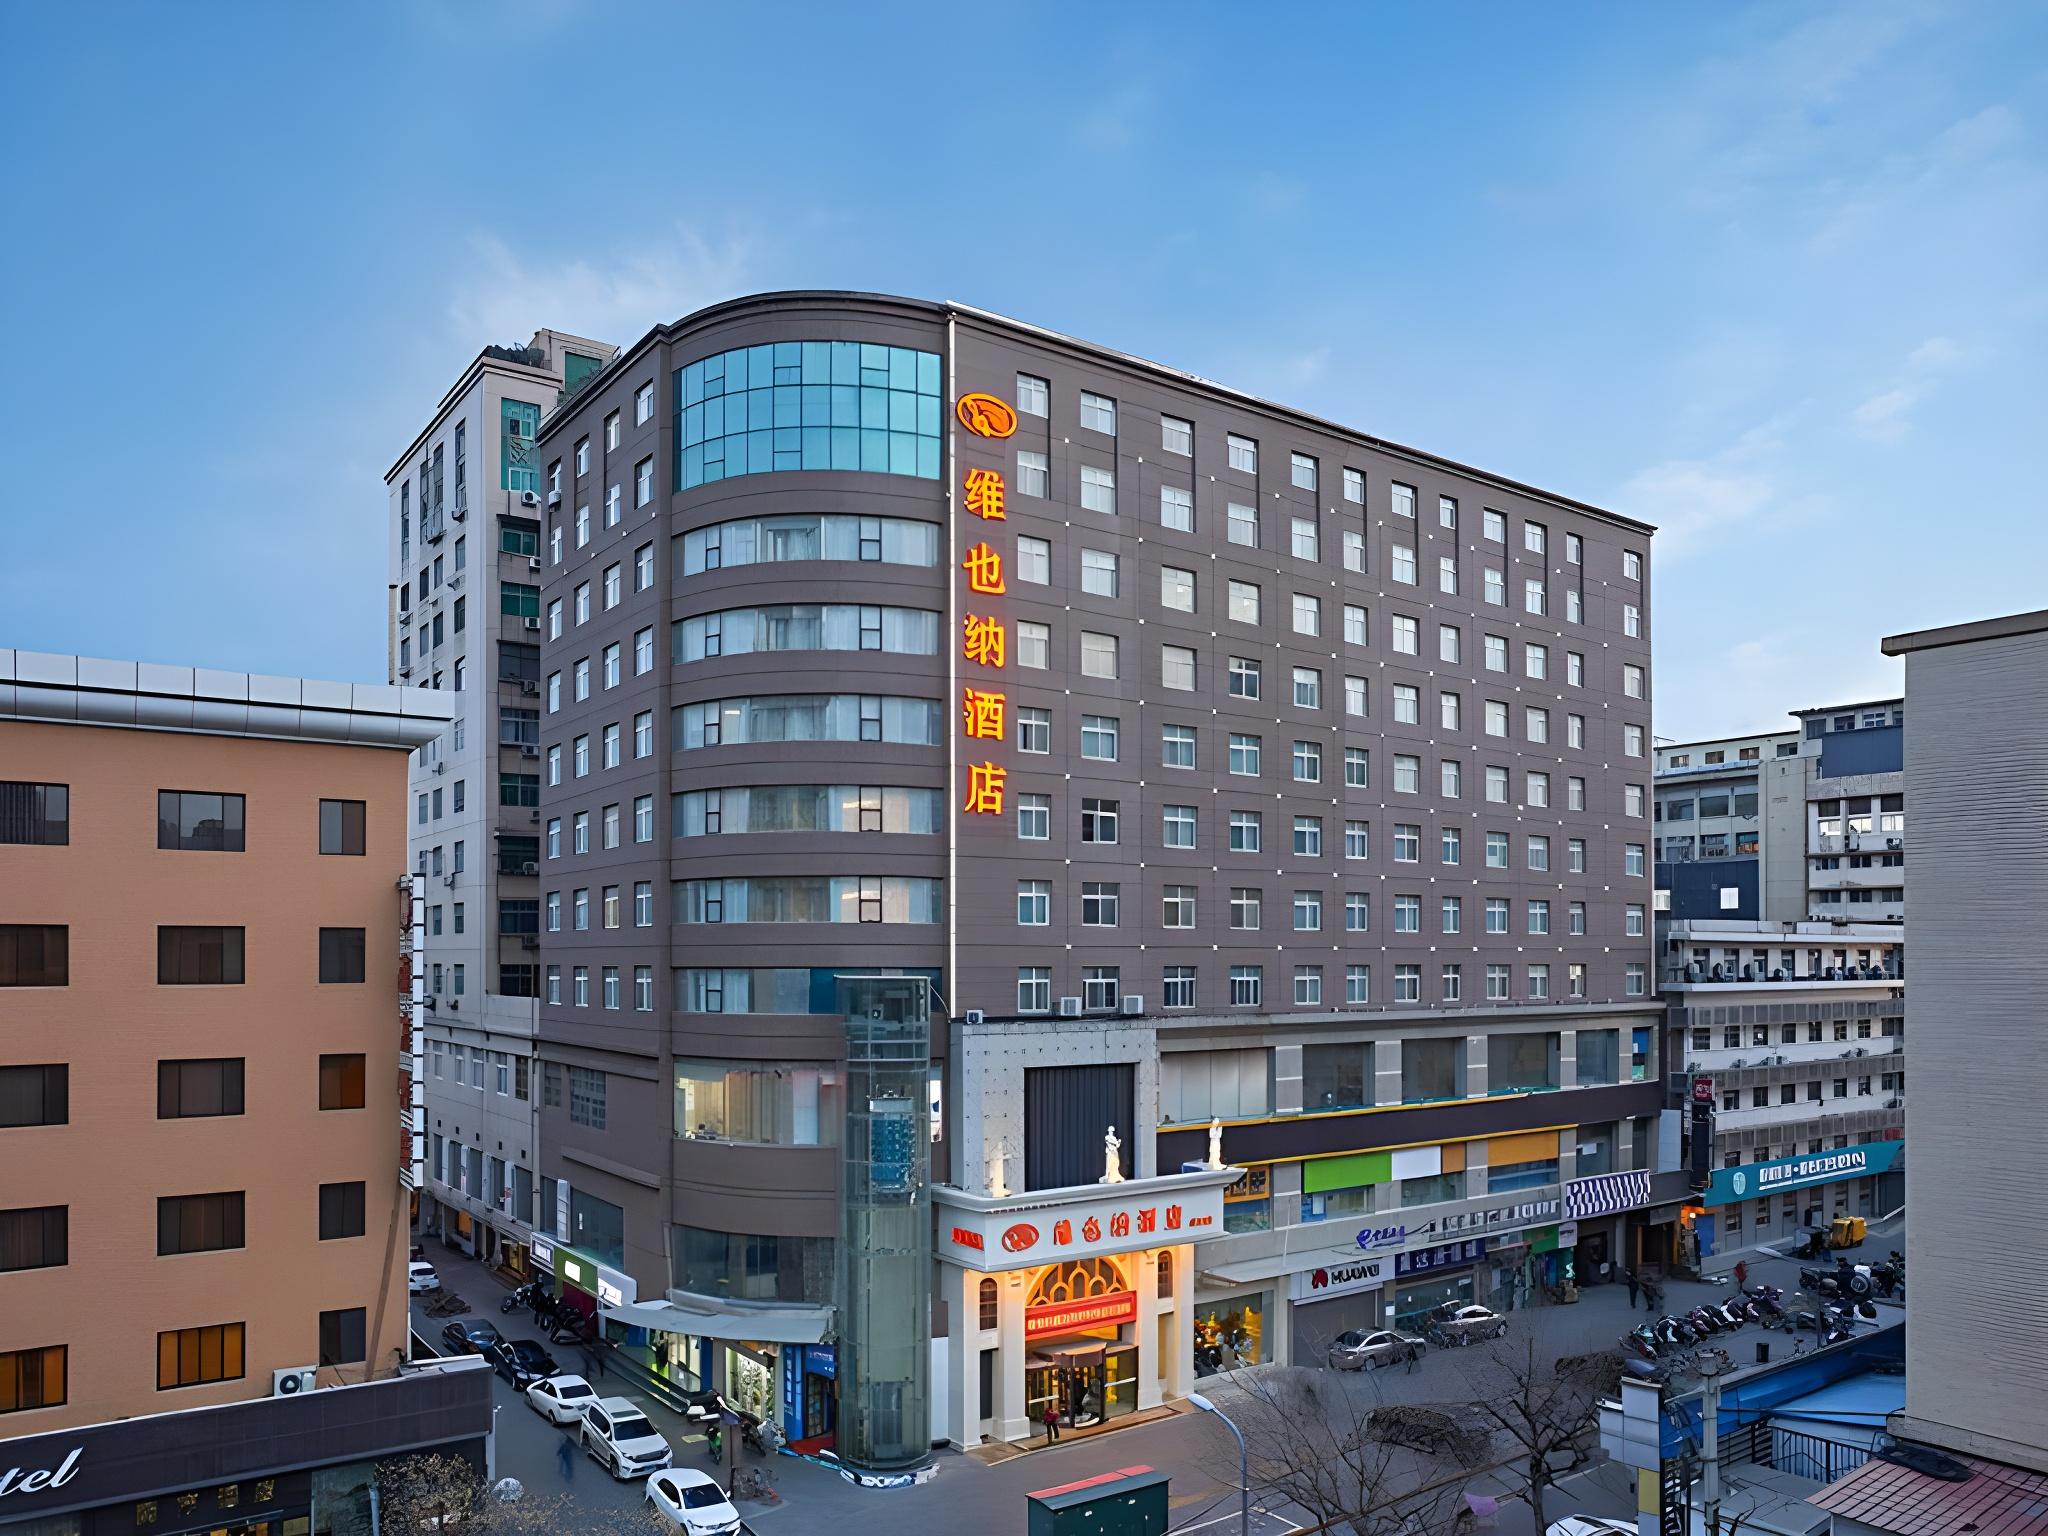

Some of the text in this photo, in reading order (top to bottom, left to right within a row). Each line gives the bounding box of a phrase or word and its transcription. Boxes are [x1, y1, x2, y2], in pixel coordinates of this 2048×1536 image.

[962, 468, 1007, 815] 维也纳酒店
